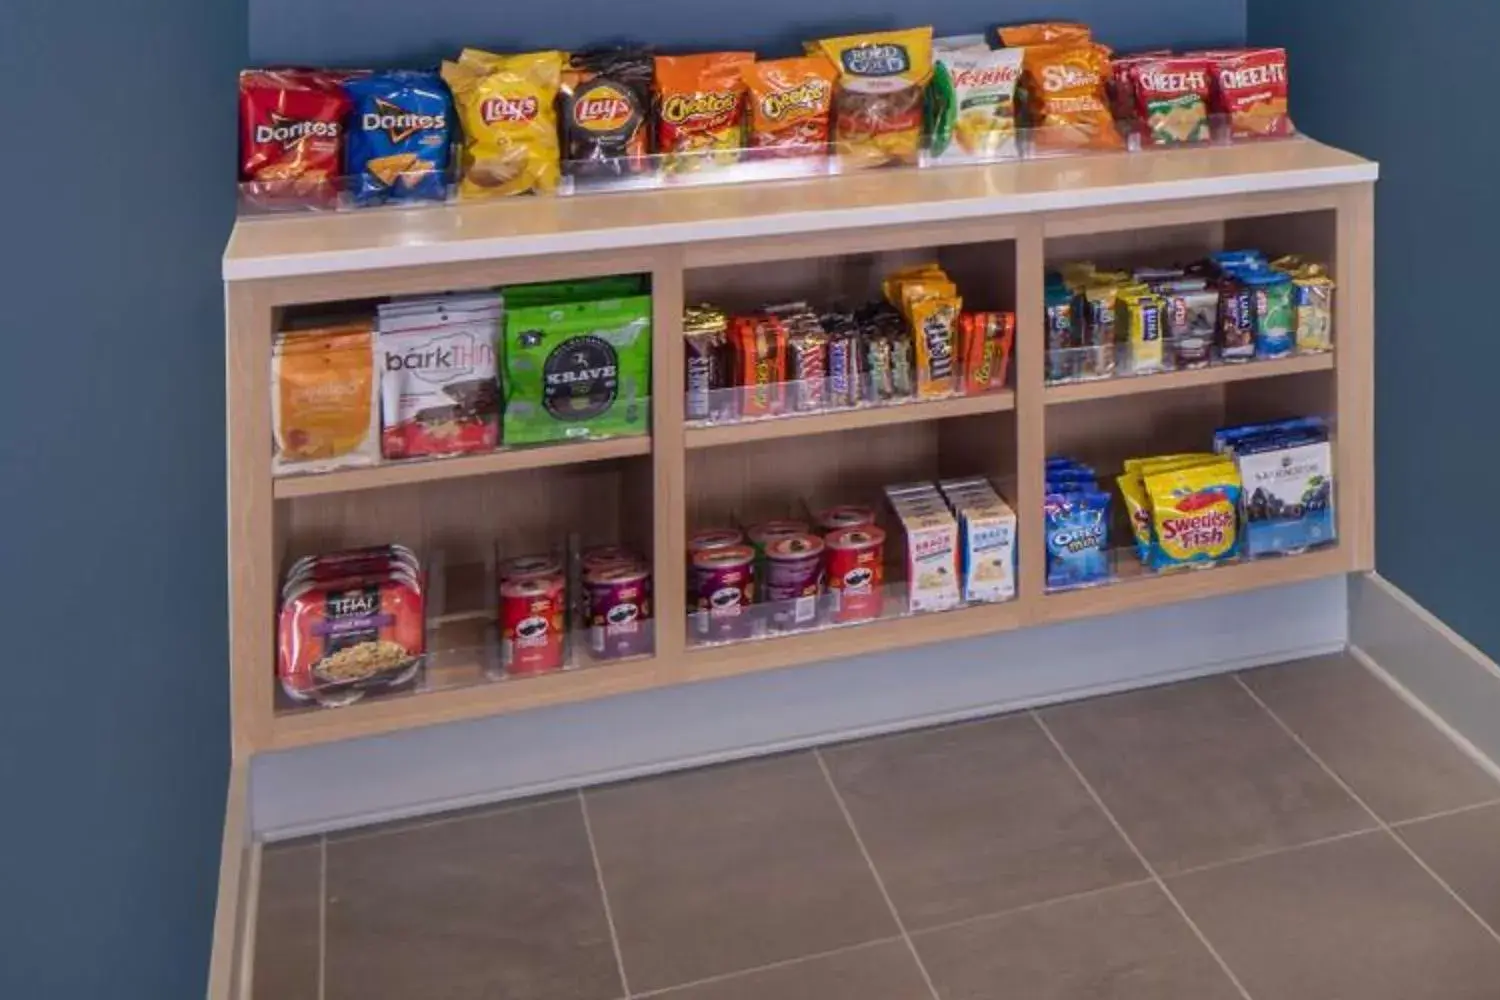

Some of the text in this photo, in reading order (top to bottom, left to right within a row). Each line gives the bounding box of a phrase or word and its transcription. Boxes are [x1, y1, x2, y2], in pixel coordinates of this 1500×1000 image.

[362, 112, 446, 131] Doritos
[256, 121, 338, 143] Doritos
[547, 366, 616, 385] KRAVE
[1181, 527, 1223, 549] Fish
[328, 597, 373, 614] THAI
